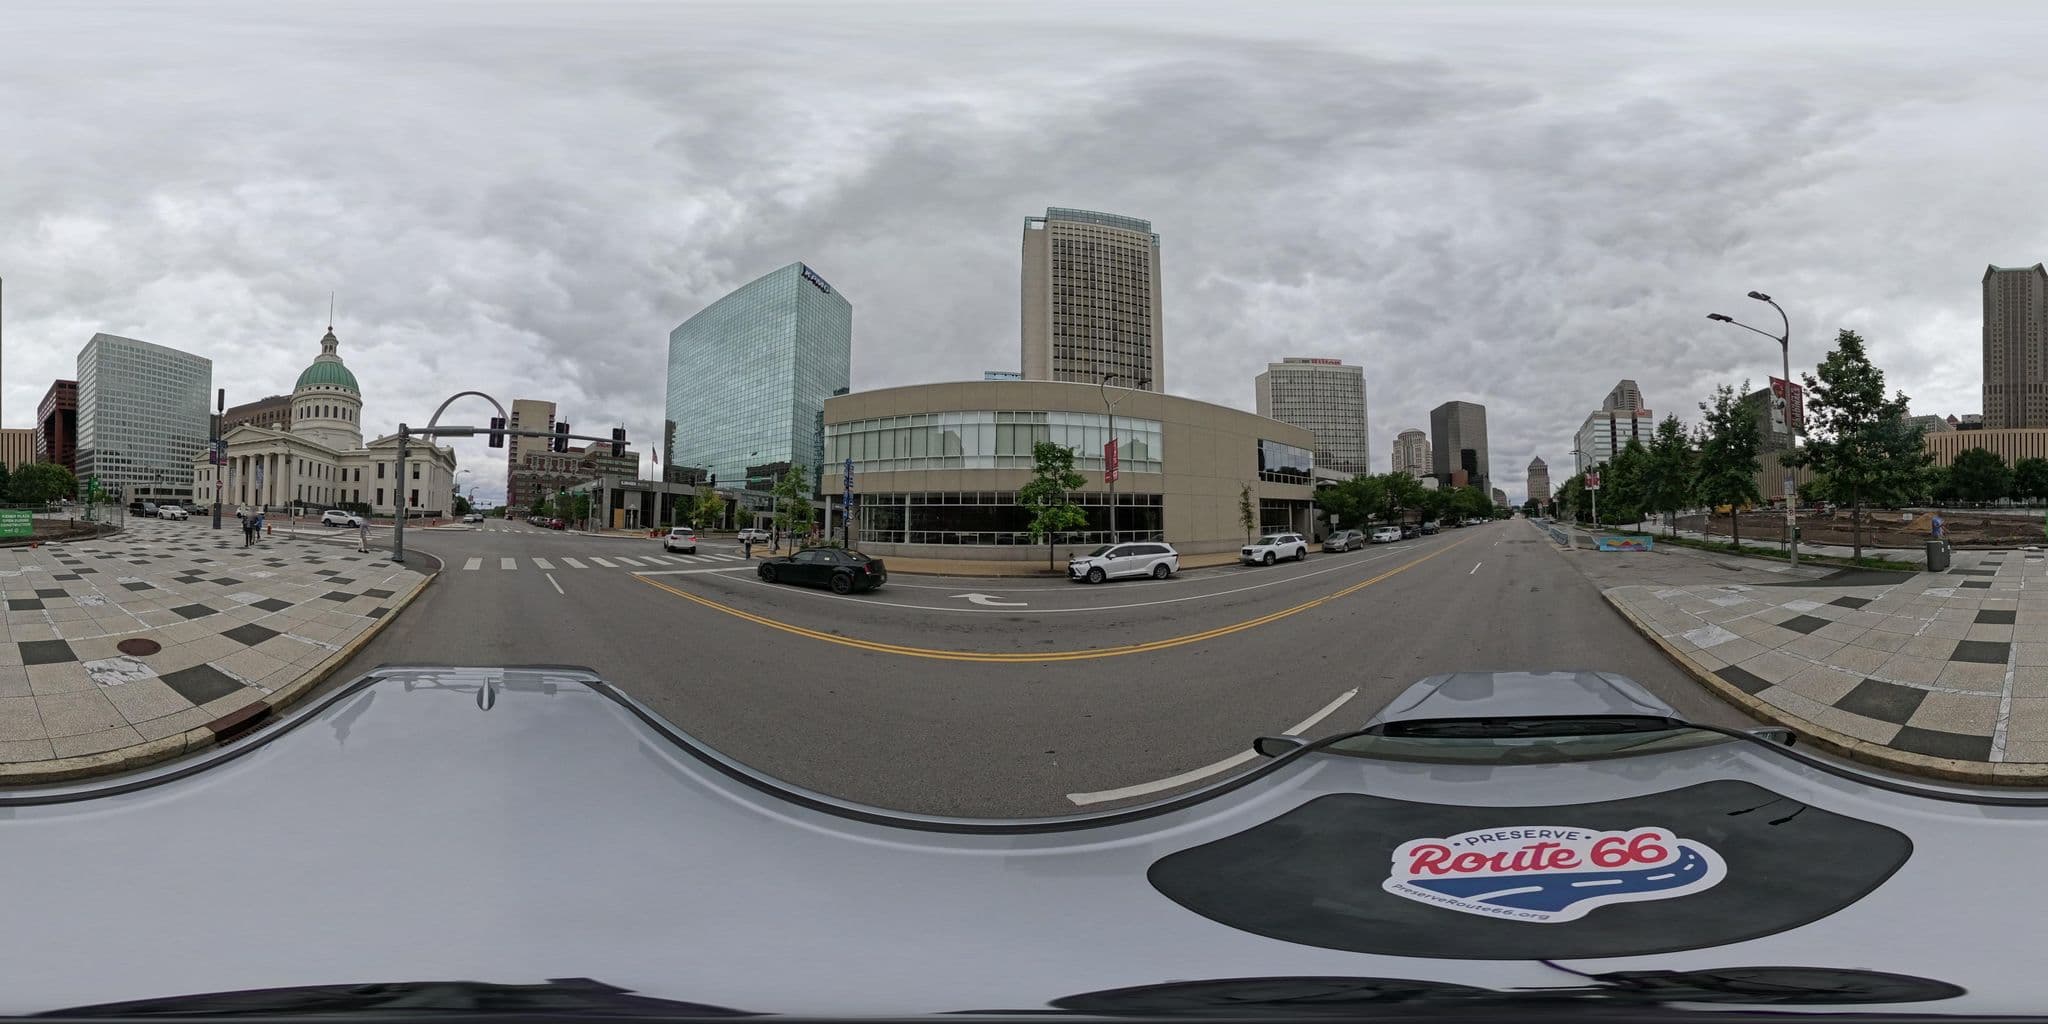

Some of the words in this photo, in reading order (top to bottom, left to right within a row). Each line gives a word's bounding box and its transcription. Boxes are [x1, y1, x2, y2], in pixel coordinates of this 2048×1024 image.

[804, 269, 830, 293] KPMG
[1466, 829, 1579, 846] PRESERVE
[1409, 842, 1582, 875] Route
[1590, 833, 1668, 868] 66
[1392, 883, 1551, 921] PreserveRoute66.org
